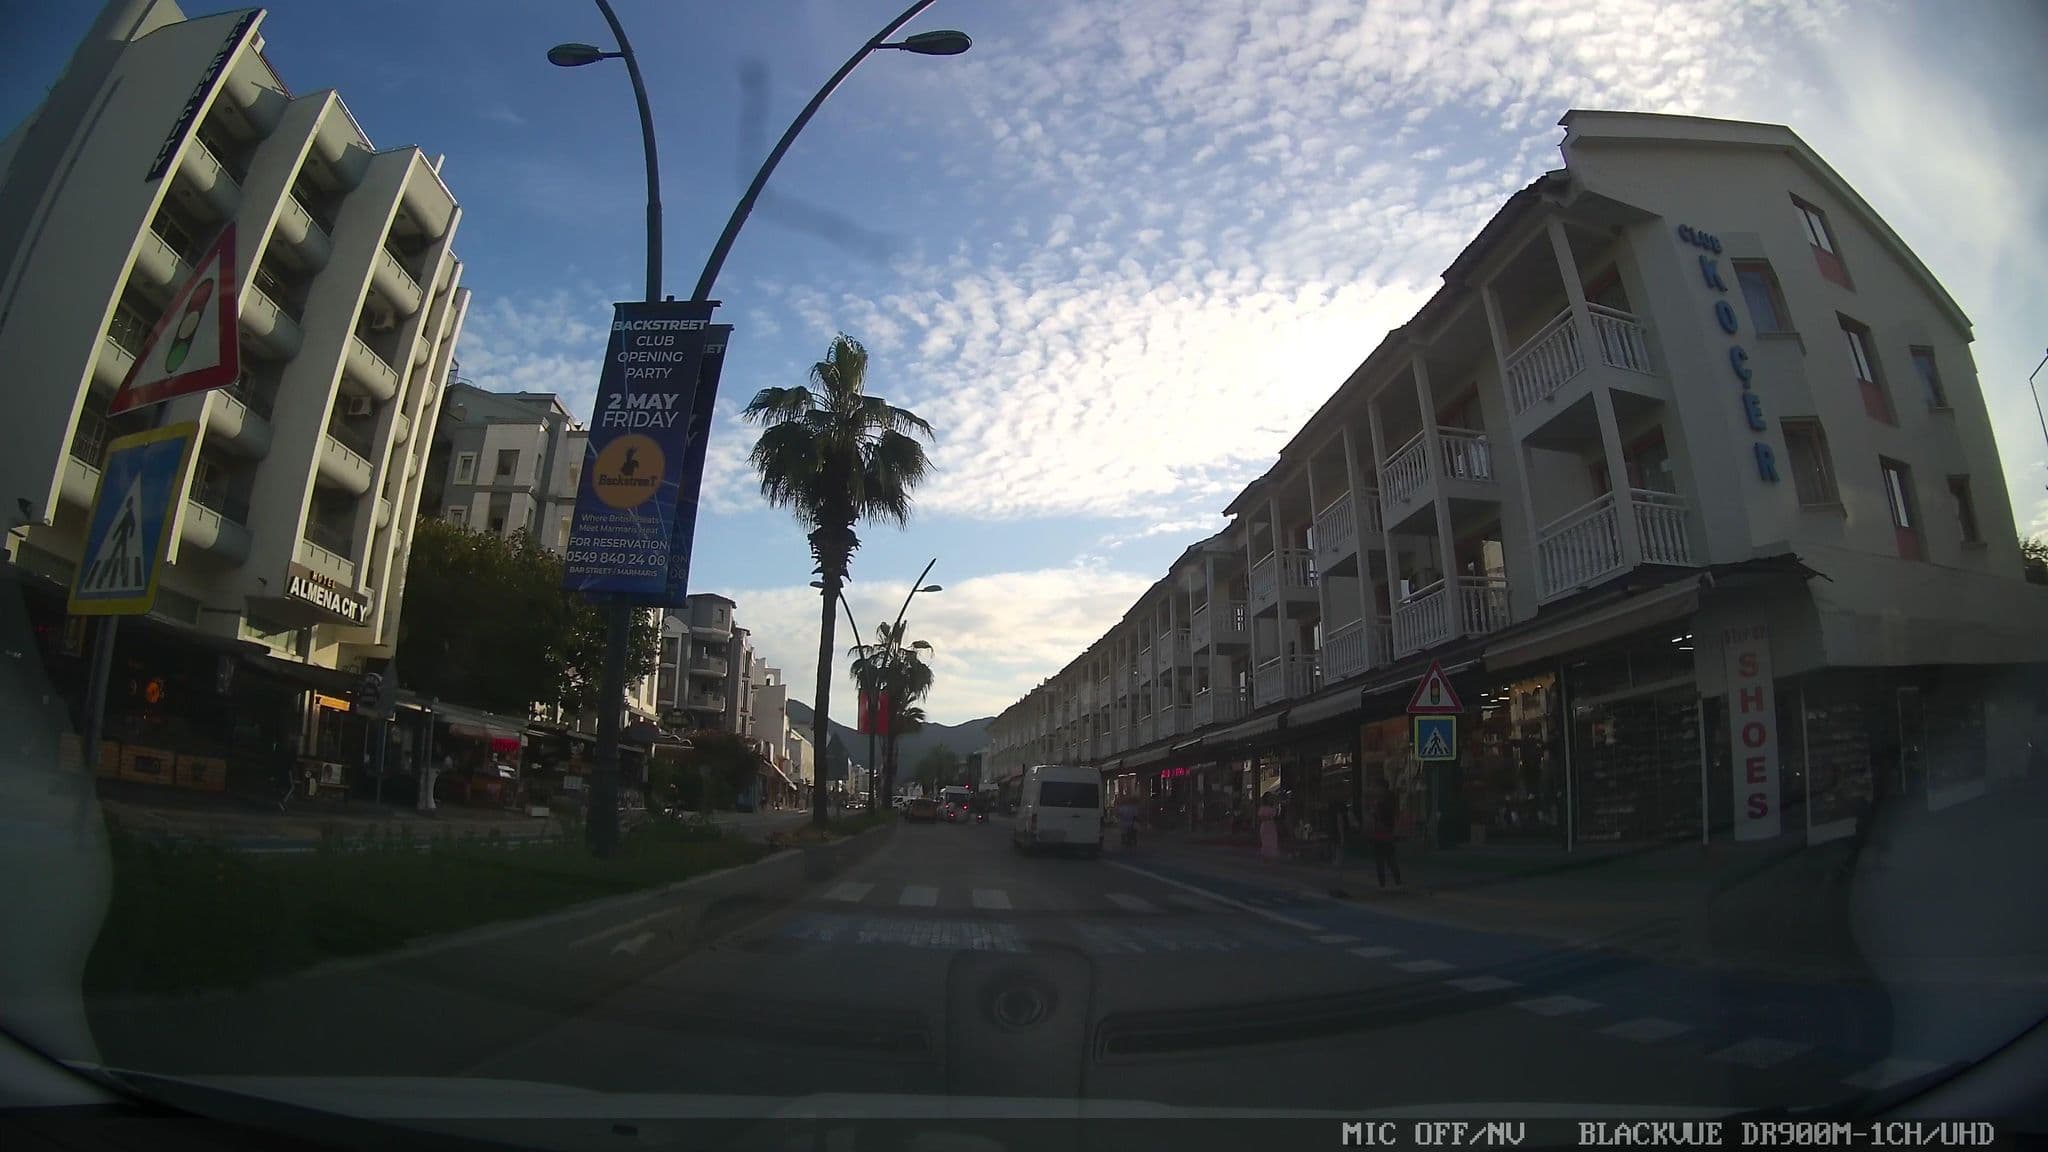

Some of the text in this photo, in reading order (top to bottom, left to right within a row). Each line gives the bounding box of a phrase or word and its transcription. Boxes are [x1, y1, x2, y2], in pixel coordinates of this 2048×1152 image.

[1678, 224, 1722, 254] CLUB
[612, 320, 708, 331] BACKSTREET
[636, 336, 675, 346] CLUB
[617, 351, 684, 363] OPENING
[626, 368, 673, 379] PARTY
[607, 393, 680, 410] 2 MAY
[602, 411, 680, 428] FRIDAY
[581, 513, 609, 523] Where
[579, 524, 599, 532] Meet
[601, 525, 638, 533] Marmaris
[569, 537, 668, 550] FOR RESERVATION
[566, 551, 598, 563] 0549
[600, 552, 626, 565] 840
[628, 553, 645, 566] 24
[648, 554, 666, 566] 00
[569, 566, 585, 574] BAR
[585, 567, 613, 575] STREET
[617, 568, 658, 577] MARMARIS
[289, 576, 368, 623] ALMENA CITY
[1738, 652, 1769, 820] SHOES
